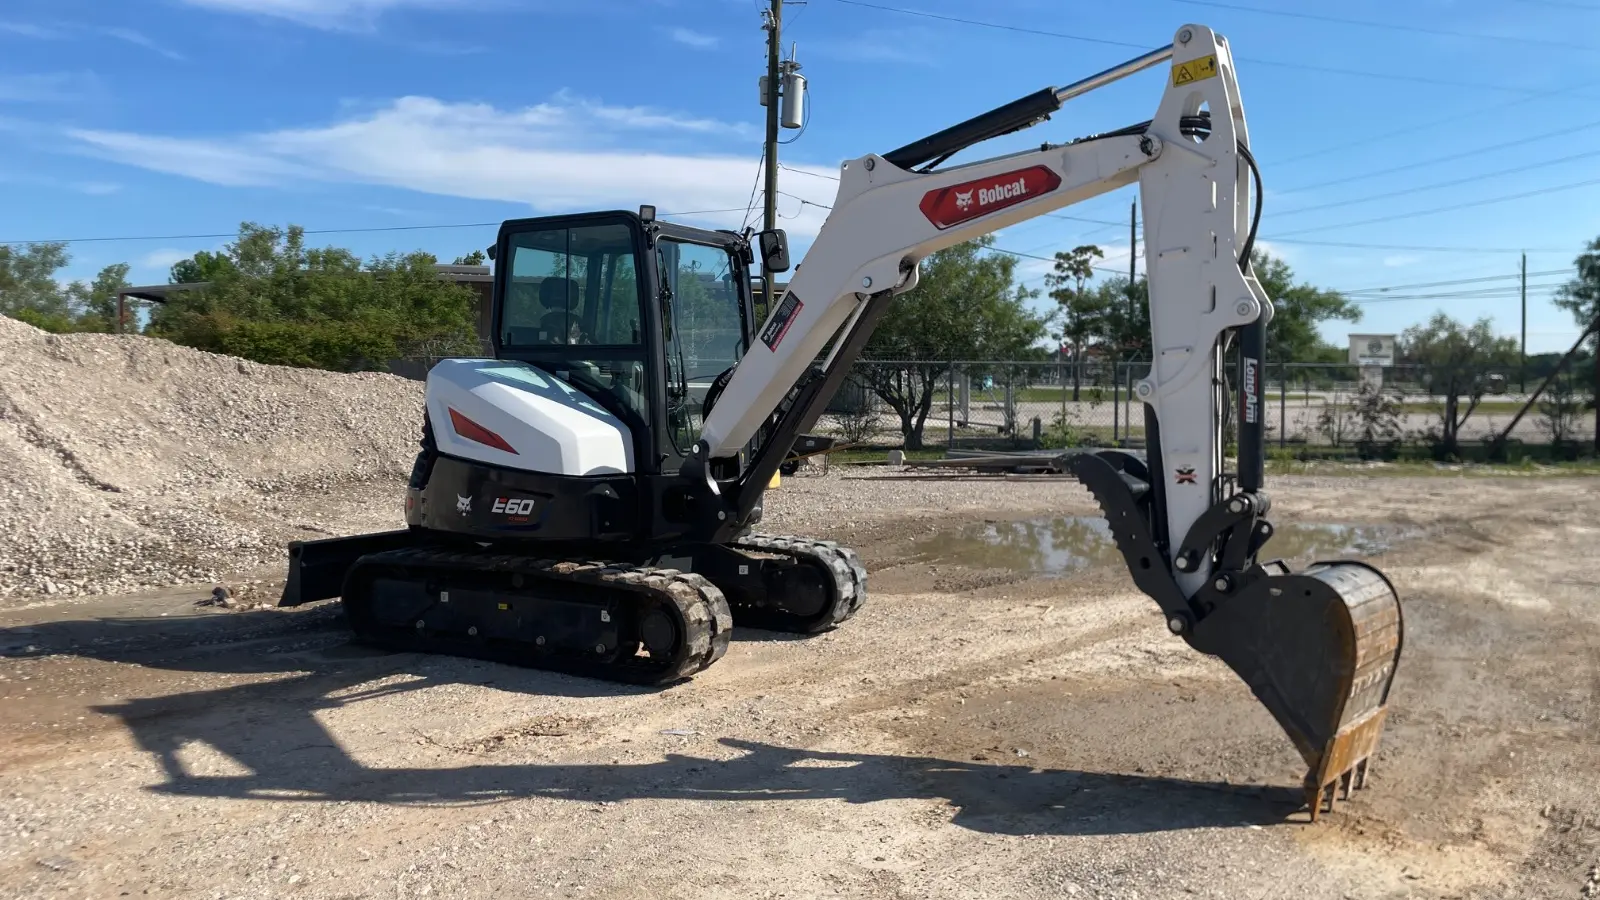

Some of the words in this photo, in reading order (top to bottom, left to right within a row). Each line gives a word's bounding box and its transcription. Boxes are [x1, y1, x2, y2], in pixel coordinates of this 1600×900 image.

[978, 177, 1026, 206] Bobcat
[1245, 357, 1258, 423] LongArm
[491, 497, 534, 515] E60
